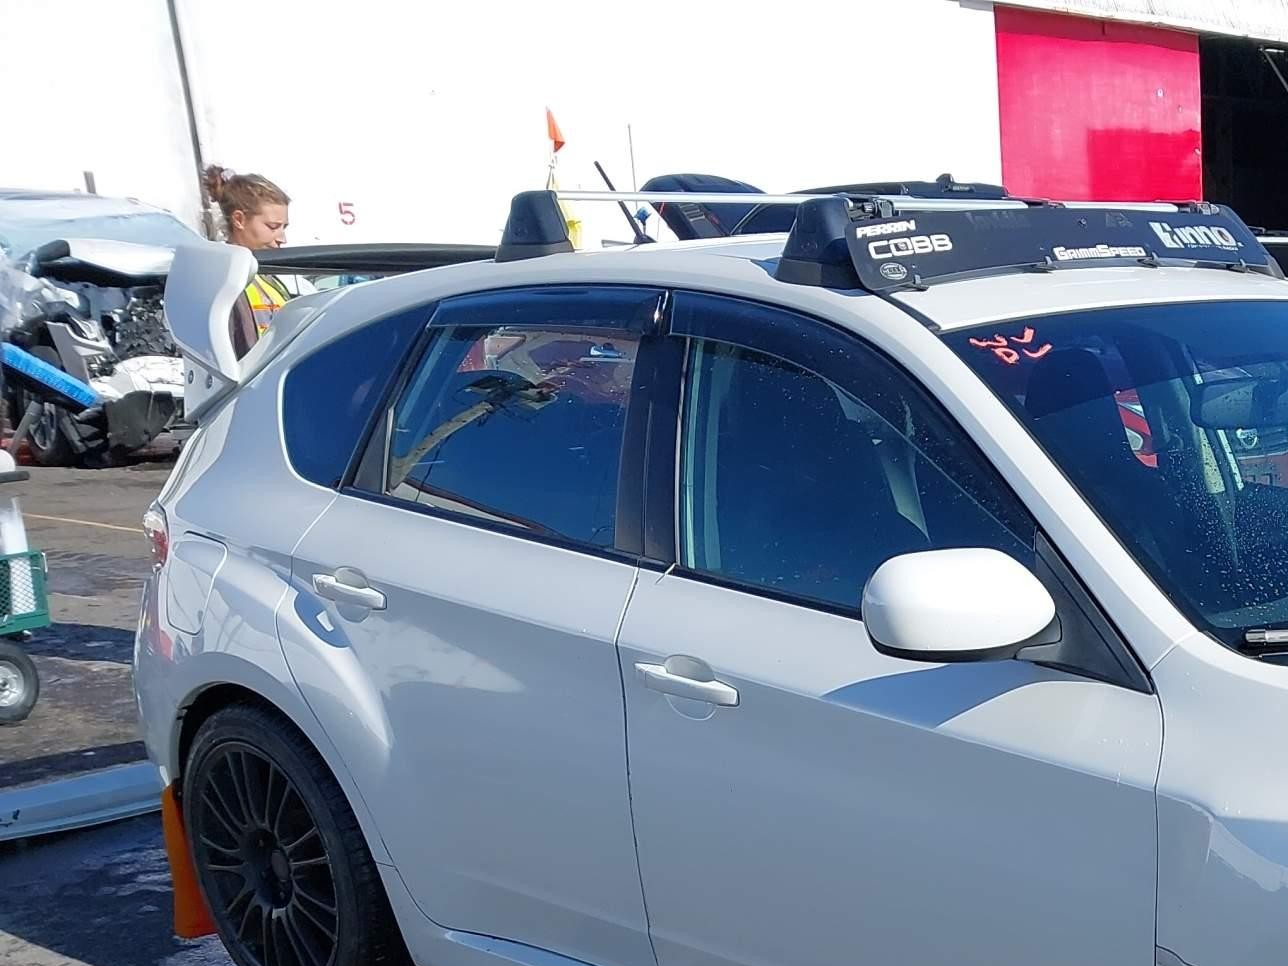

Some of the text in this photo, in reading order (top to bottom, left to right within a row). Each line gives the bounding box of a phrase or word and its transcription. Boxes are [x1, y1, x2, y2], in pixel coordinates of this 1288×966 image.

[338, 202, 356, 226] 5
[856, 220, 916, 239] PERRIN
[868, 234, 953, 259] COBB
